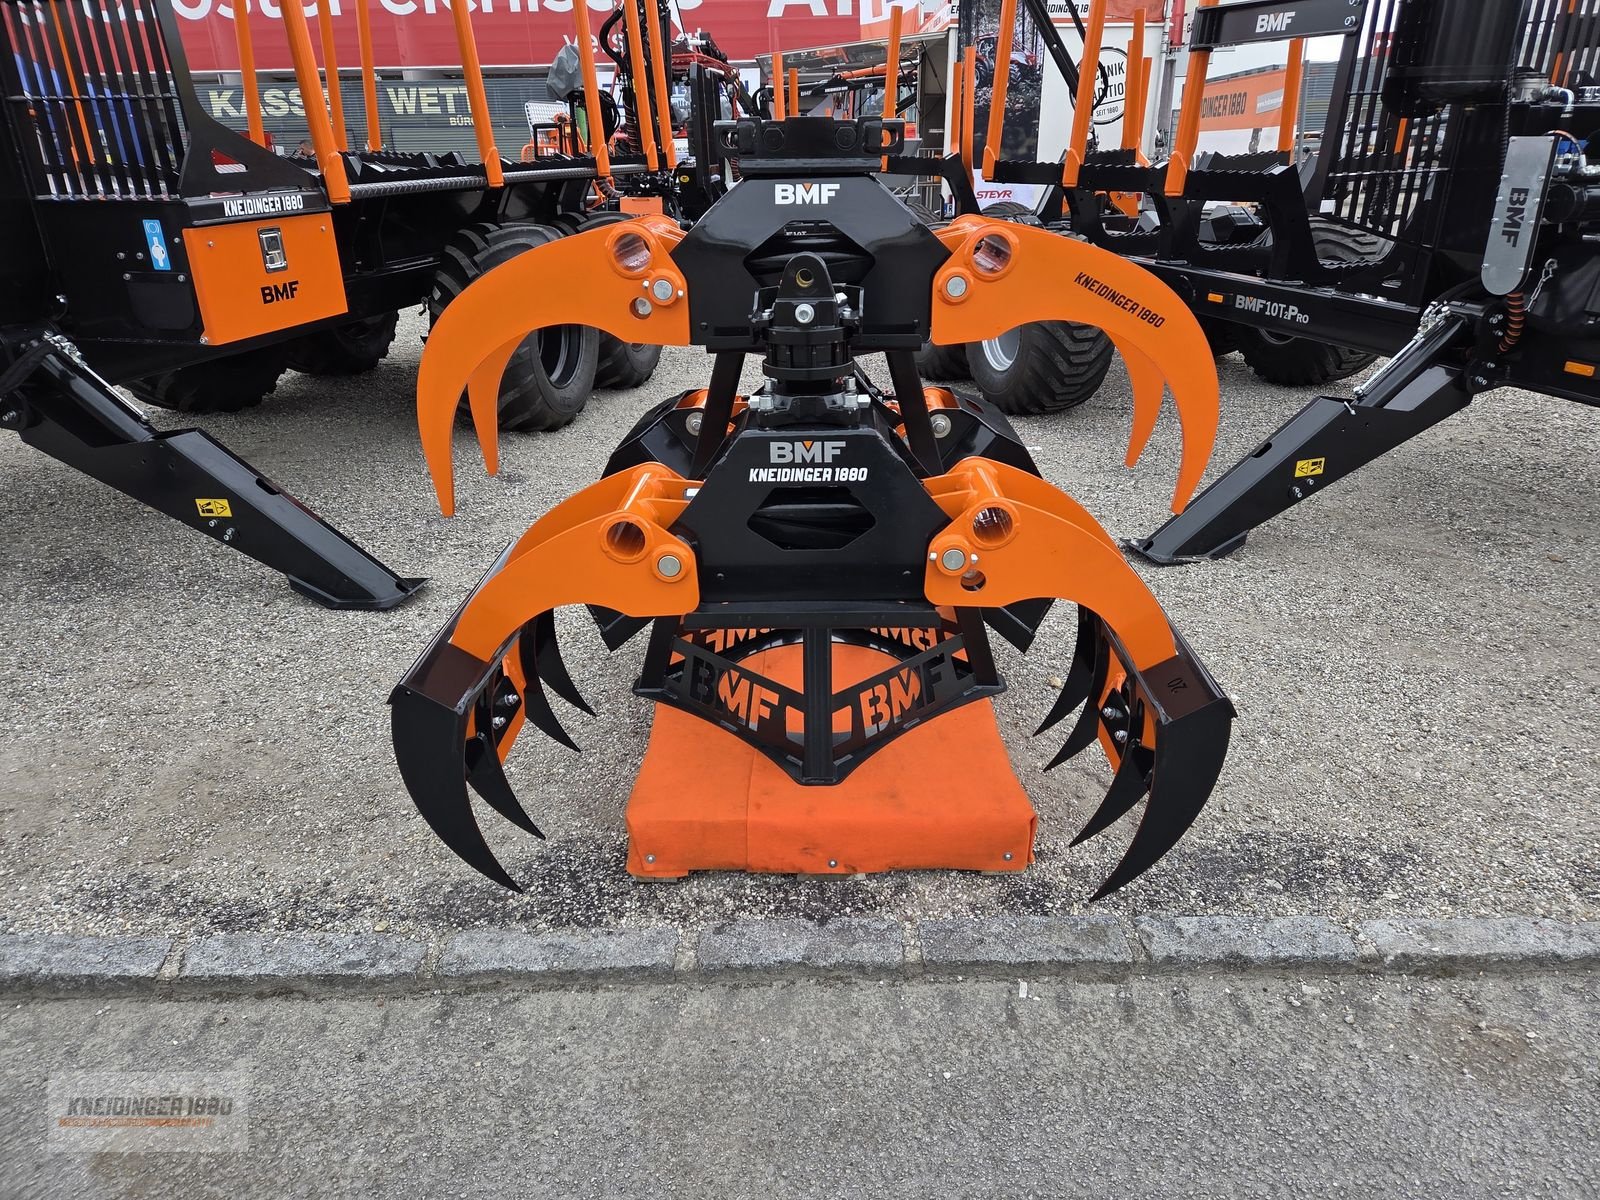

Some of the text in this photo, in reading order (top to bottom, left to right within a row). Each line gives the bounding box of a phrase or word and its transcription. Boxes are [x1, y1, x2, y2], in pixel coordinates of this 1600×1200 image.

[1256, 12, 1296, 33] BMF
[1228, 92, 1248, 116] 1880
[774, 182, 840, 205] BMF
[976, 190, 1012, 199] STEYR
[223, 195, 304, 217] KNEIDINGER 1880
[1502, 187, 1530, 248] BMF
[261, 280, 299, 304] BMF
[1074, 271, 1166, 328] KNEIDINGER 1880
[769, 441, 847, 464] BMF
[749, 467, 868, 482] KNEIDINGER 1880
[689, 655, 780, 732] BMF
[859, 652, 946, 740] BMF
